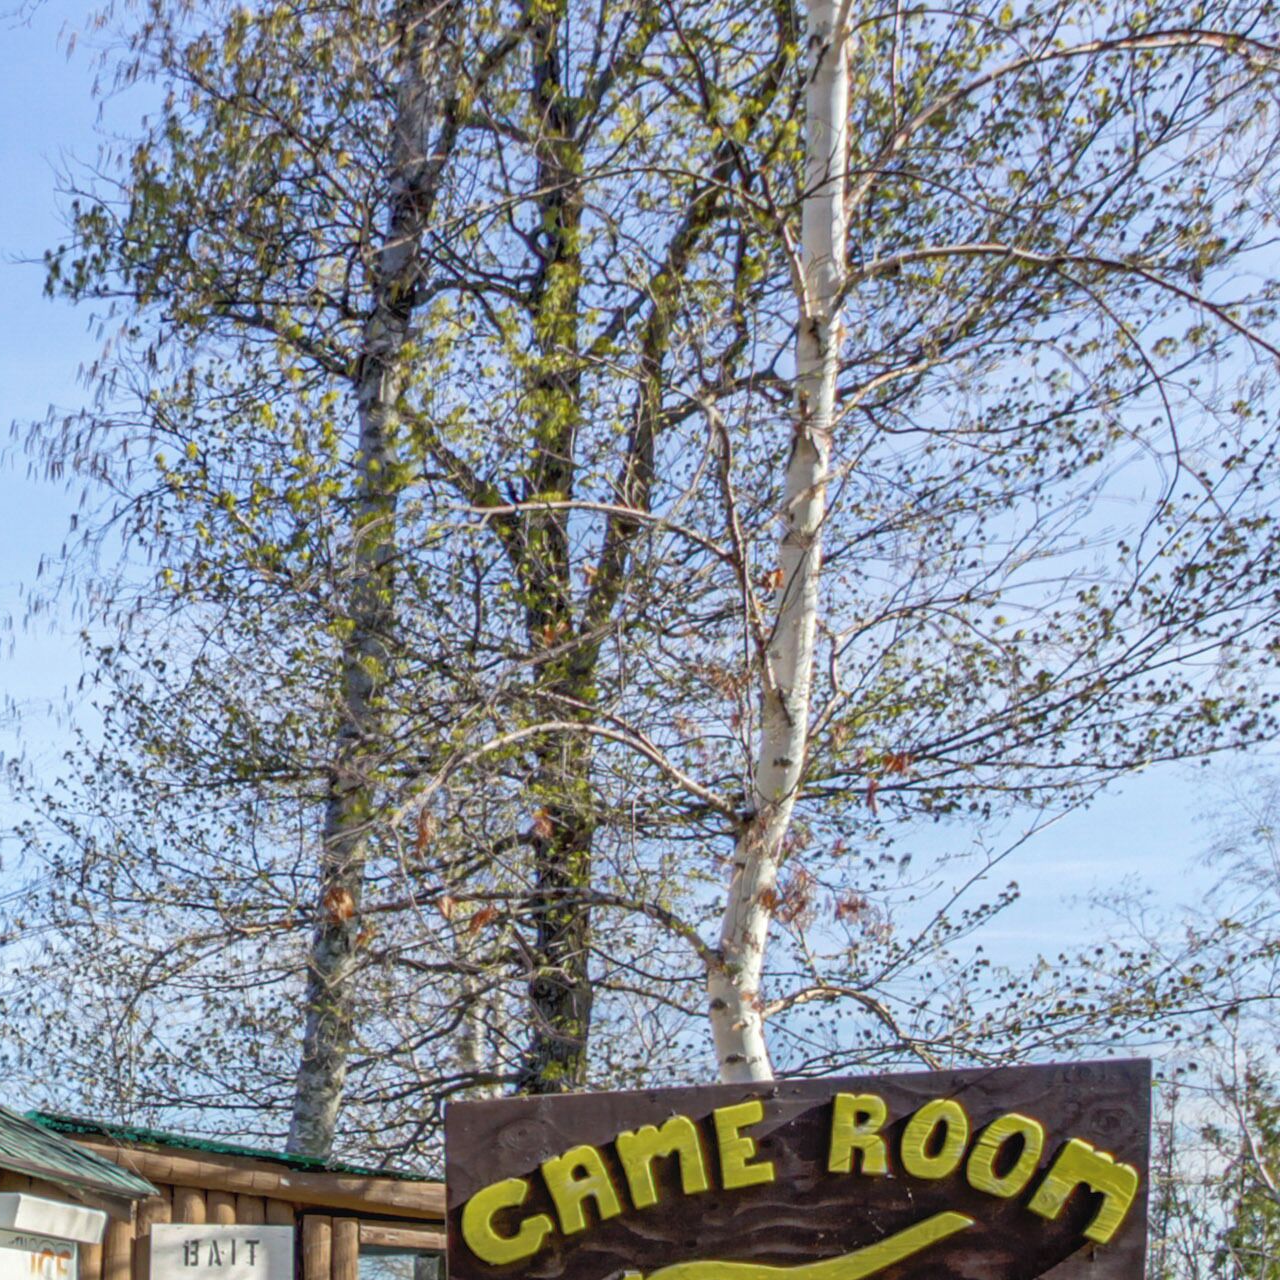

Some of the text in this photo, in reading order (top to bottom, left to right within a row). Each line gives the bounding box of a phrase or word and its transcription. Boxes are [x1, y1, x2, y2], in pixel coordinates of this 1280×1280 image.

[460, 1092, 1141, 1268] GAME ROOM
[182, 1239, 260, 1266] BAIT
